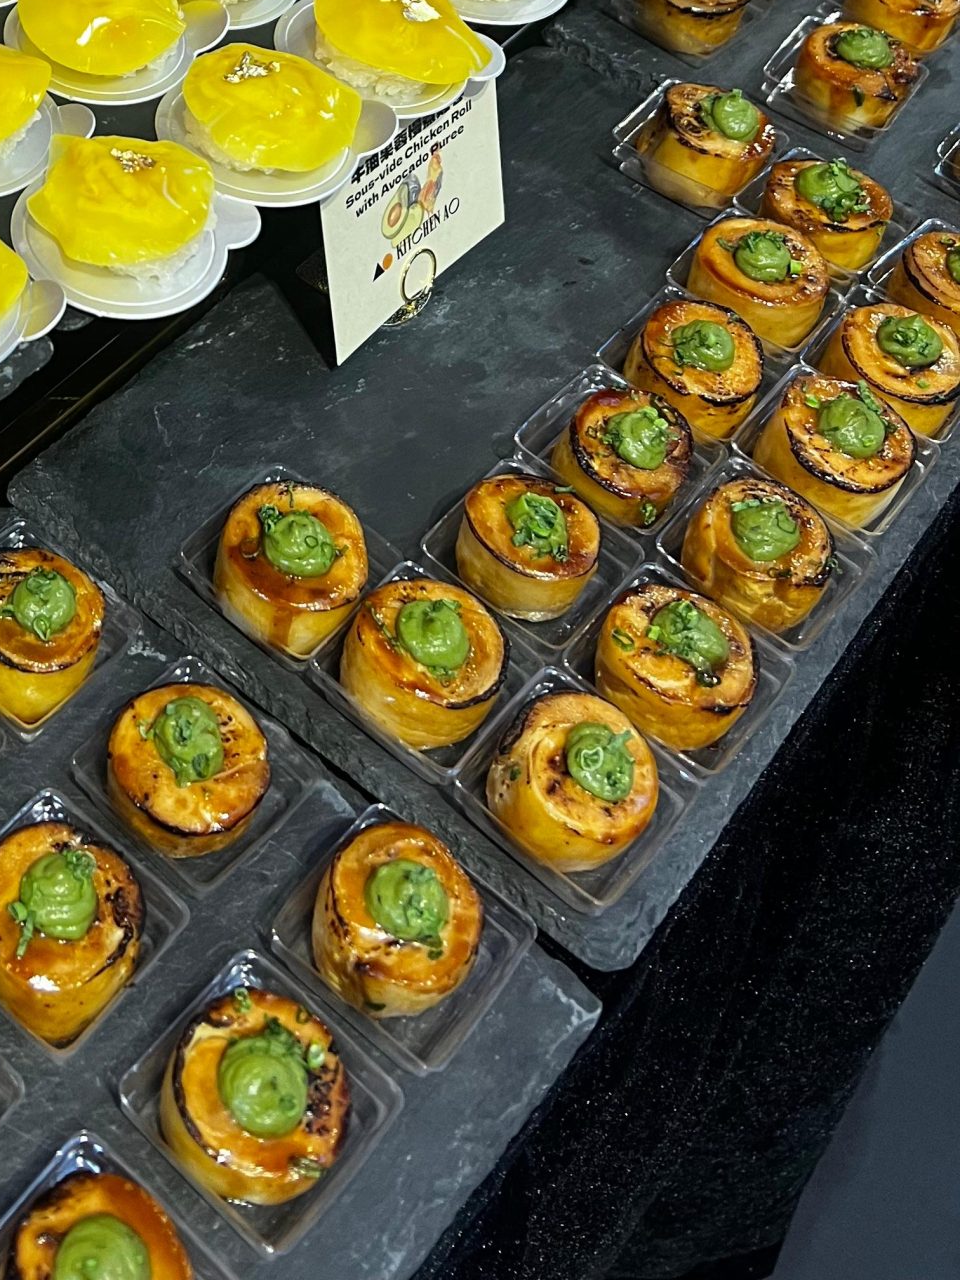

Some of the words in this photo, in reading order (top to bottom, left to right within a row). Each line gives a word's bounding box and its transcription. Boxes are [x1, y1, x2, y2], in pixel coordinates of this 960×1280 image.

[345, 156, 403, 210] Sous-vide
[404, 119, 450, 160] Chicken
[451, 98, 472, 124] Roll
[355, 192, 380, 218] with
[380, 152, 429, 198] Avocado
[430, 124, 465, 156] Puree
[396, 209, 441, 260] KITCHEN
[443, 197, 460, 222] AO
